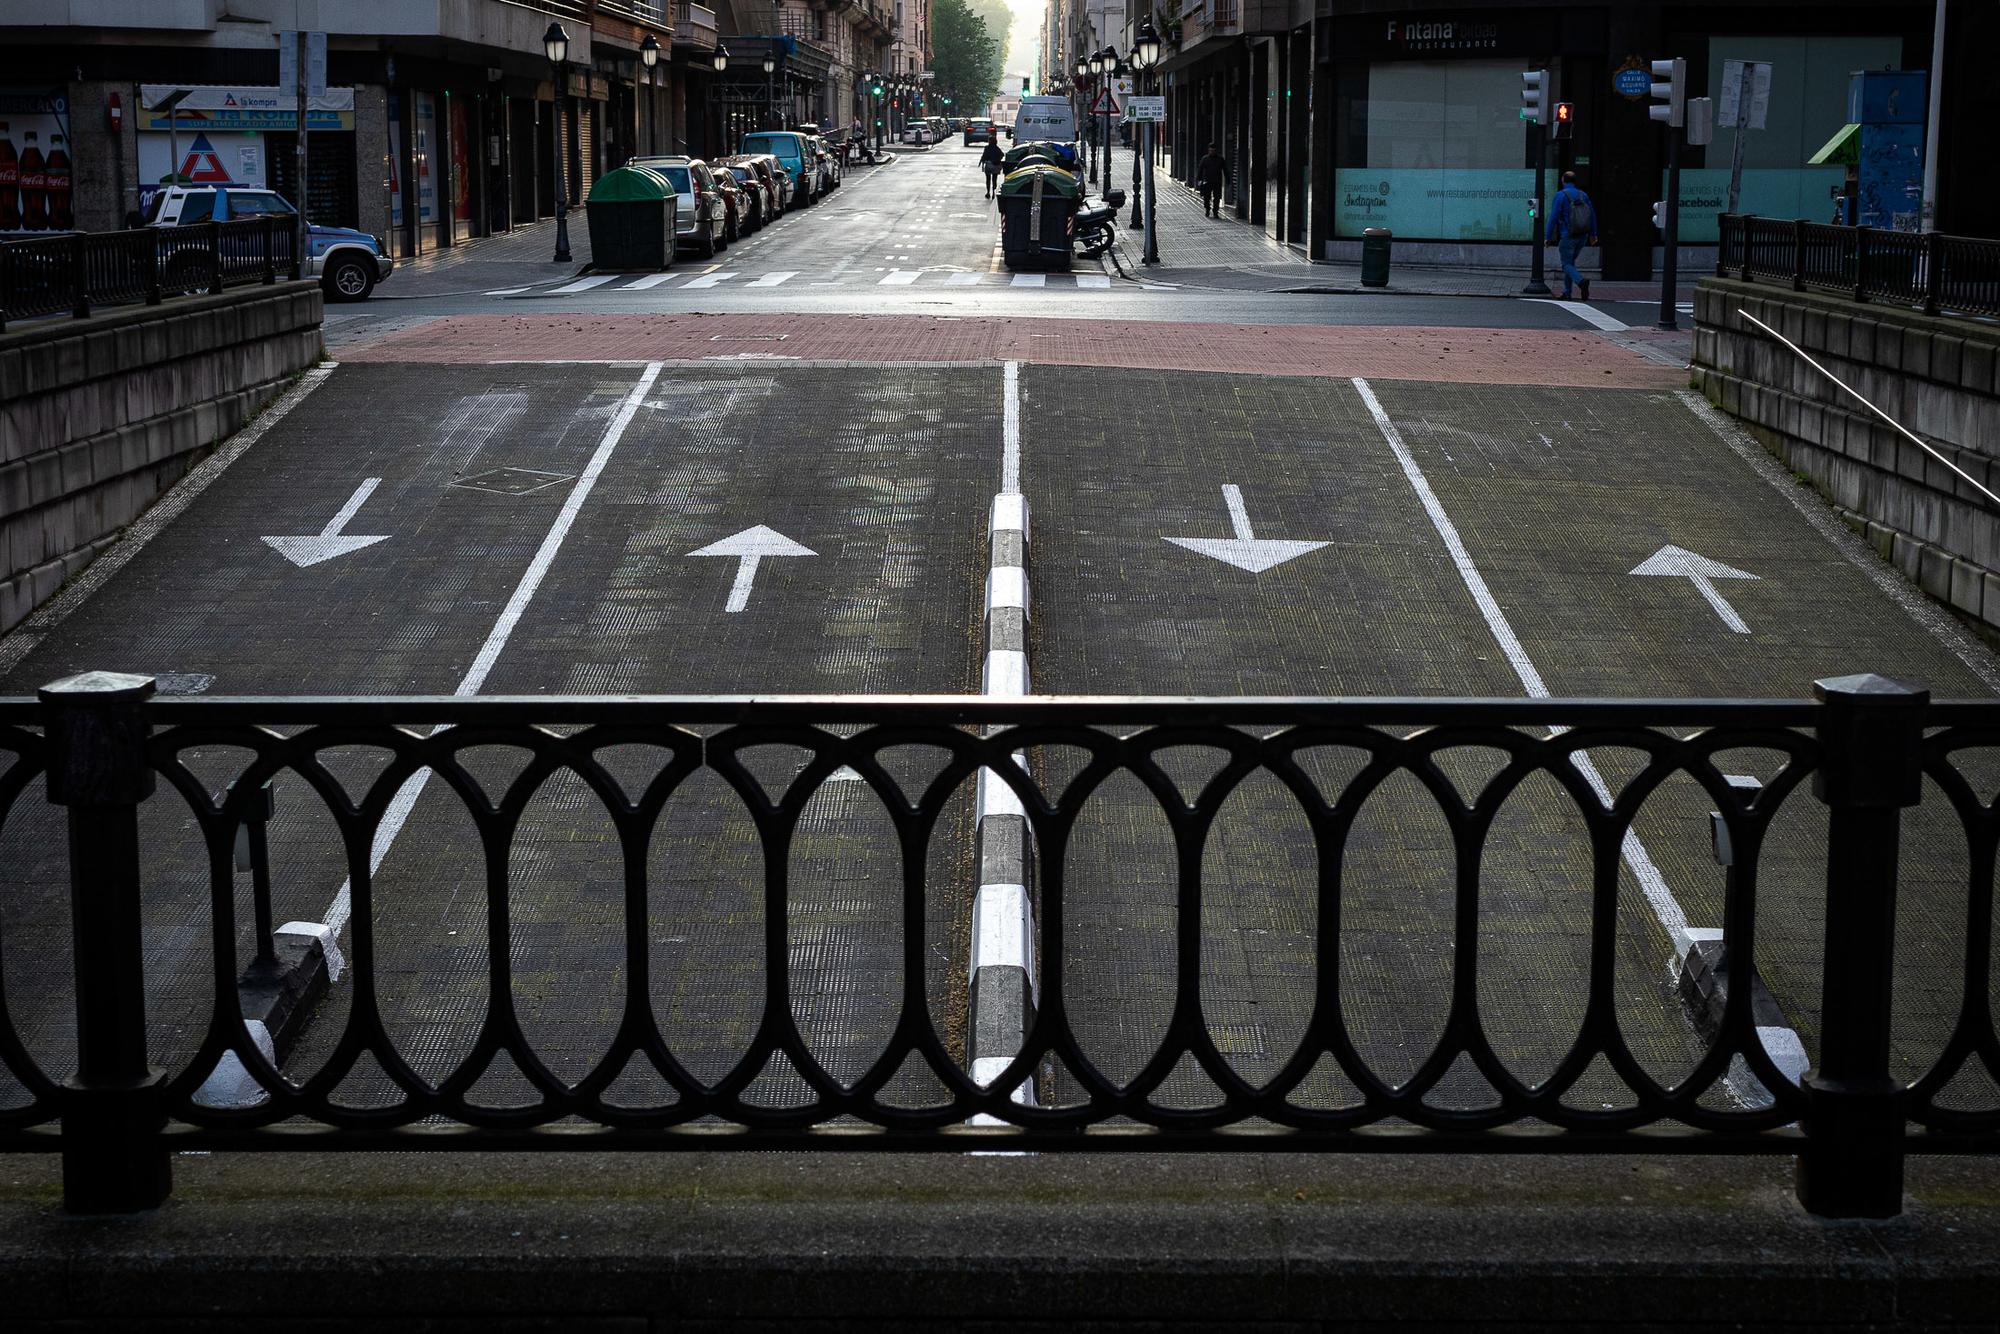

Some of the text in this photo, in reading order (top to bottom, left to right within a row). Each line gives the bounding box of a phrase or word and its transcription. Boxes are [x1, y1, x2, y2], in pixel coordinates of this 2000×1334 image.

[1409, 40, 1497, 49] restaurante
[249, 97, 277, 109] kompra
[1344, 193, 1387, 213] Instagram
[1678, 196, 1723, 208] acebook
